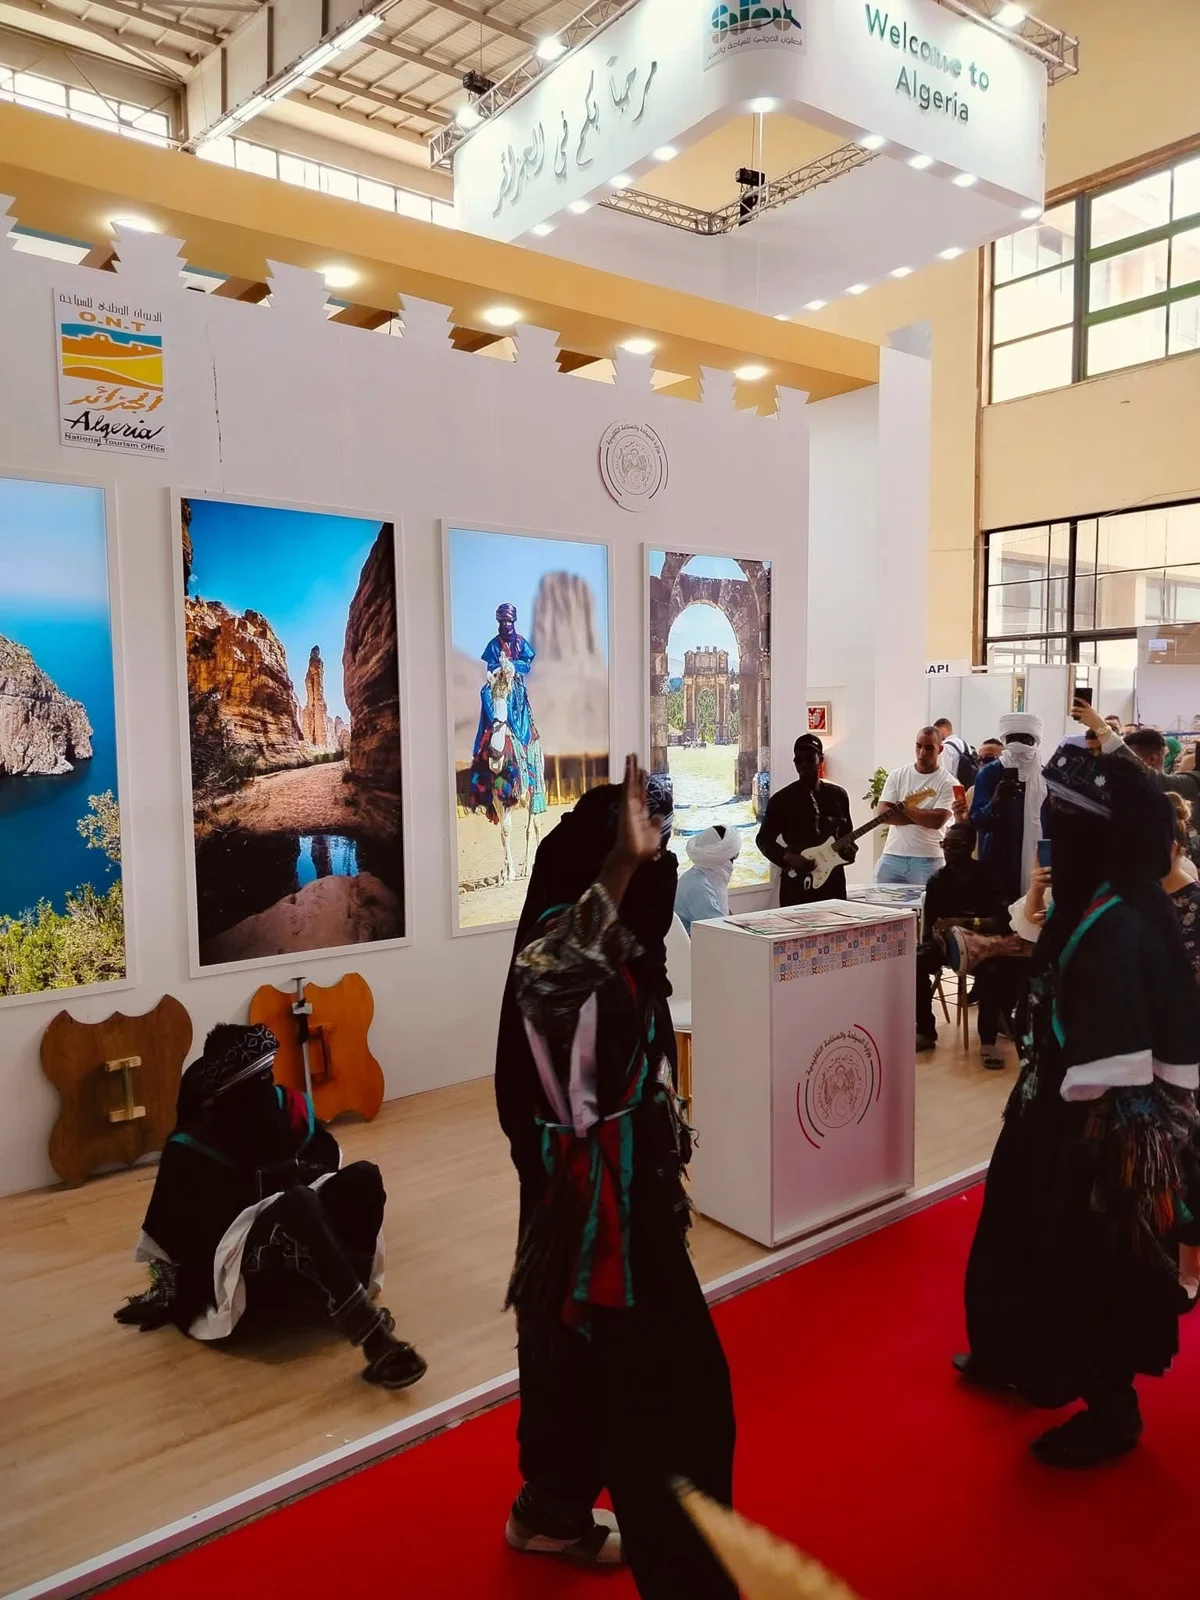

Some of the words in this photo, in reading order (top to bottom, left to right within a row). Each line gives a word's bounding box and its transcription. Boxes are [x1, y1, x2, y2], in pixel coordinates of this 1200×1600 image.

[865, 3, 962, 78] Welcome
[968, 62, 990, 91] to
[895, 66, 969, 122] Algeria
[79, 311, 146, 333] O.N.T
[63, 410, 165, 447] Algeria
[64, 433, 102, 443] National
[105, 439, 139, 449] Tourism
[140, 444, 166, 453] Office
